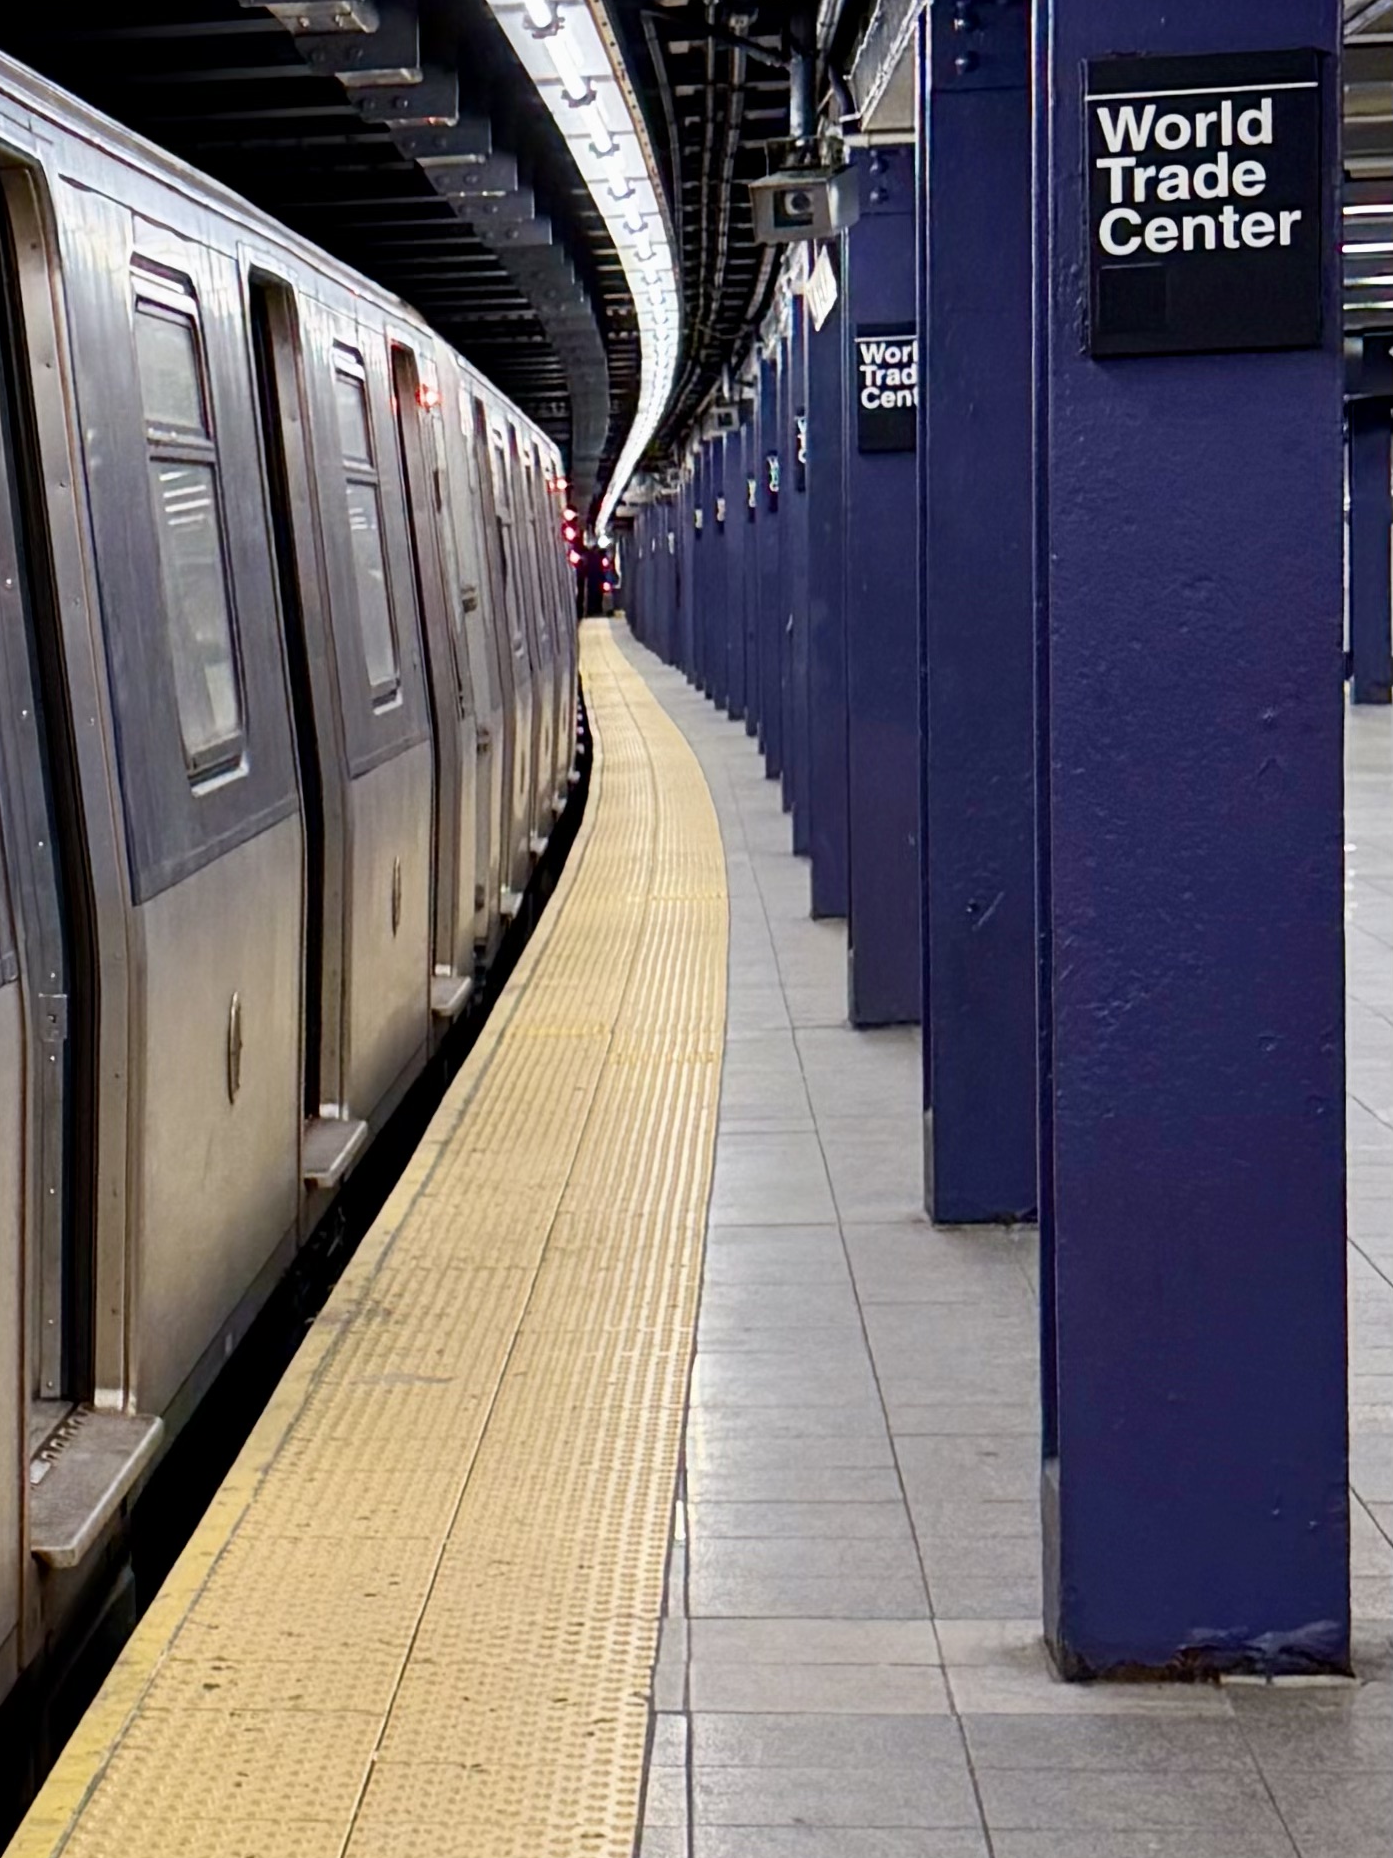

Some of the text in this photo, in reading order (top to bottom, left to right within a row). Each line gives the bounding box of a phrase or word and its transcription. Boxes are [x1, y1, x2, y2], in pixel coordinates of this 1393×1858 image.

[1097, 98, 1273, 153] World
[1097, 152, 1267, 204] Trade
[1098, 206, 1302, 256] Center
[859, 363, 917, 386] Trad
[860, 340, 918, 364] Worl
